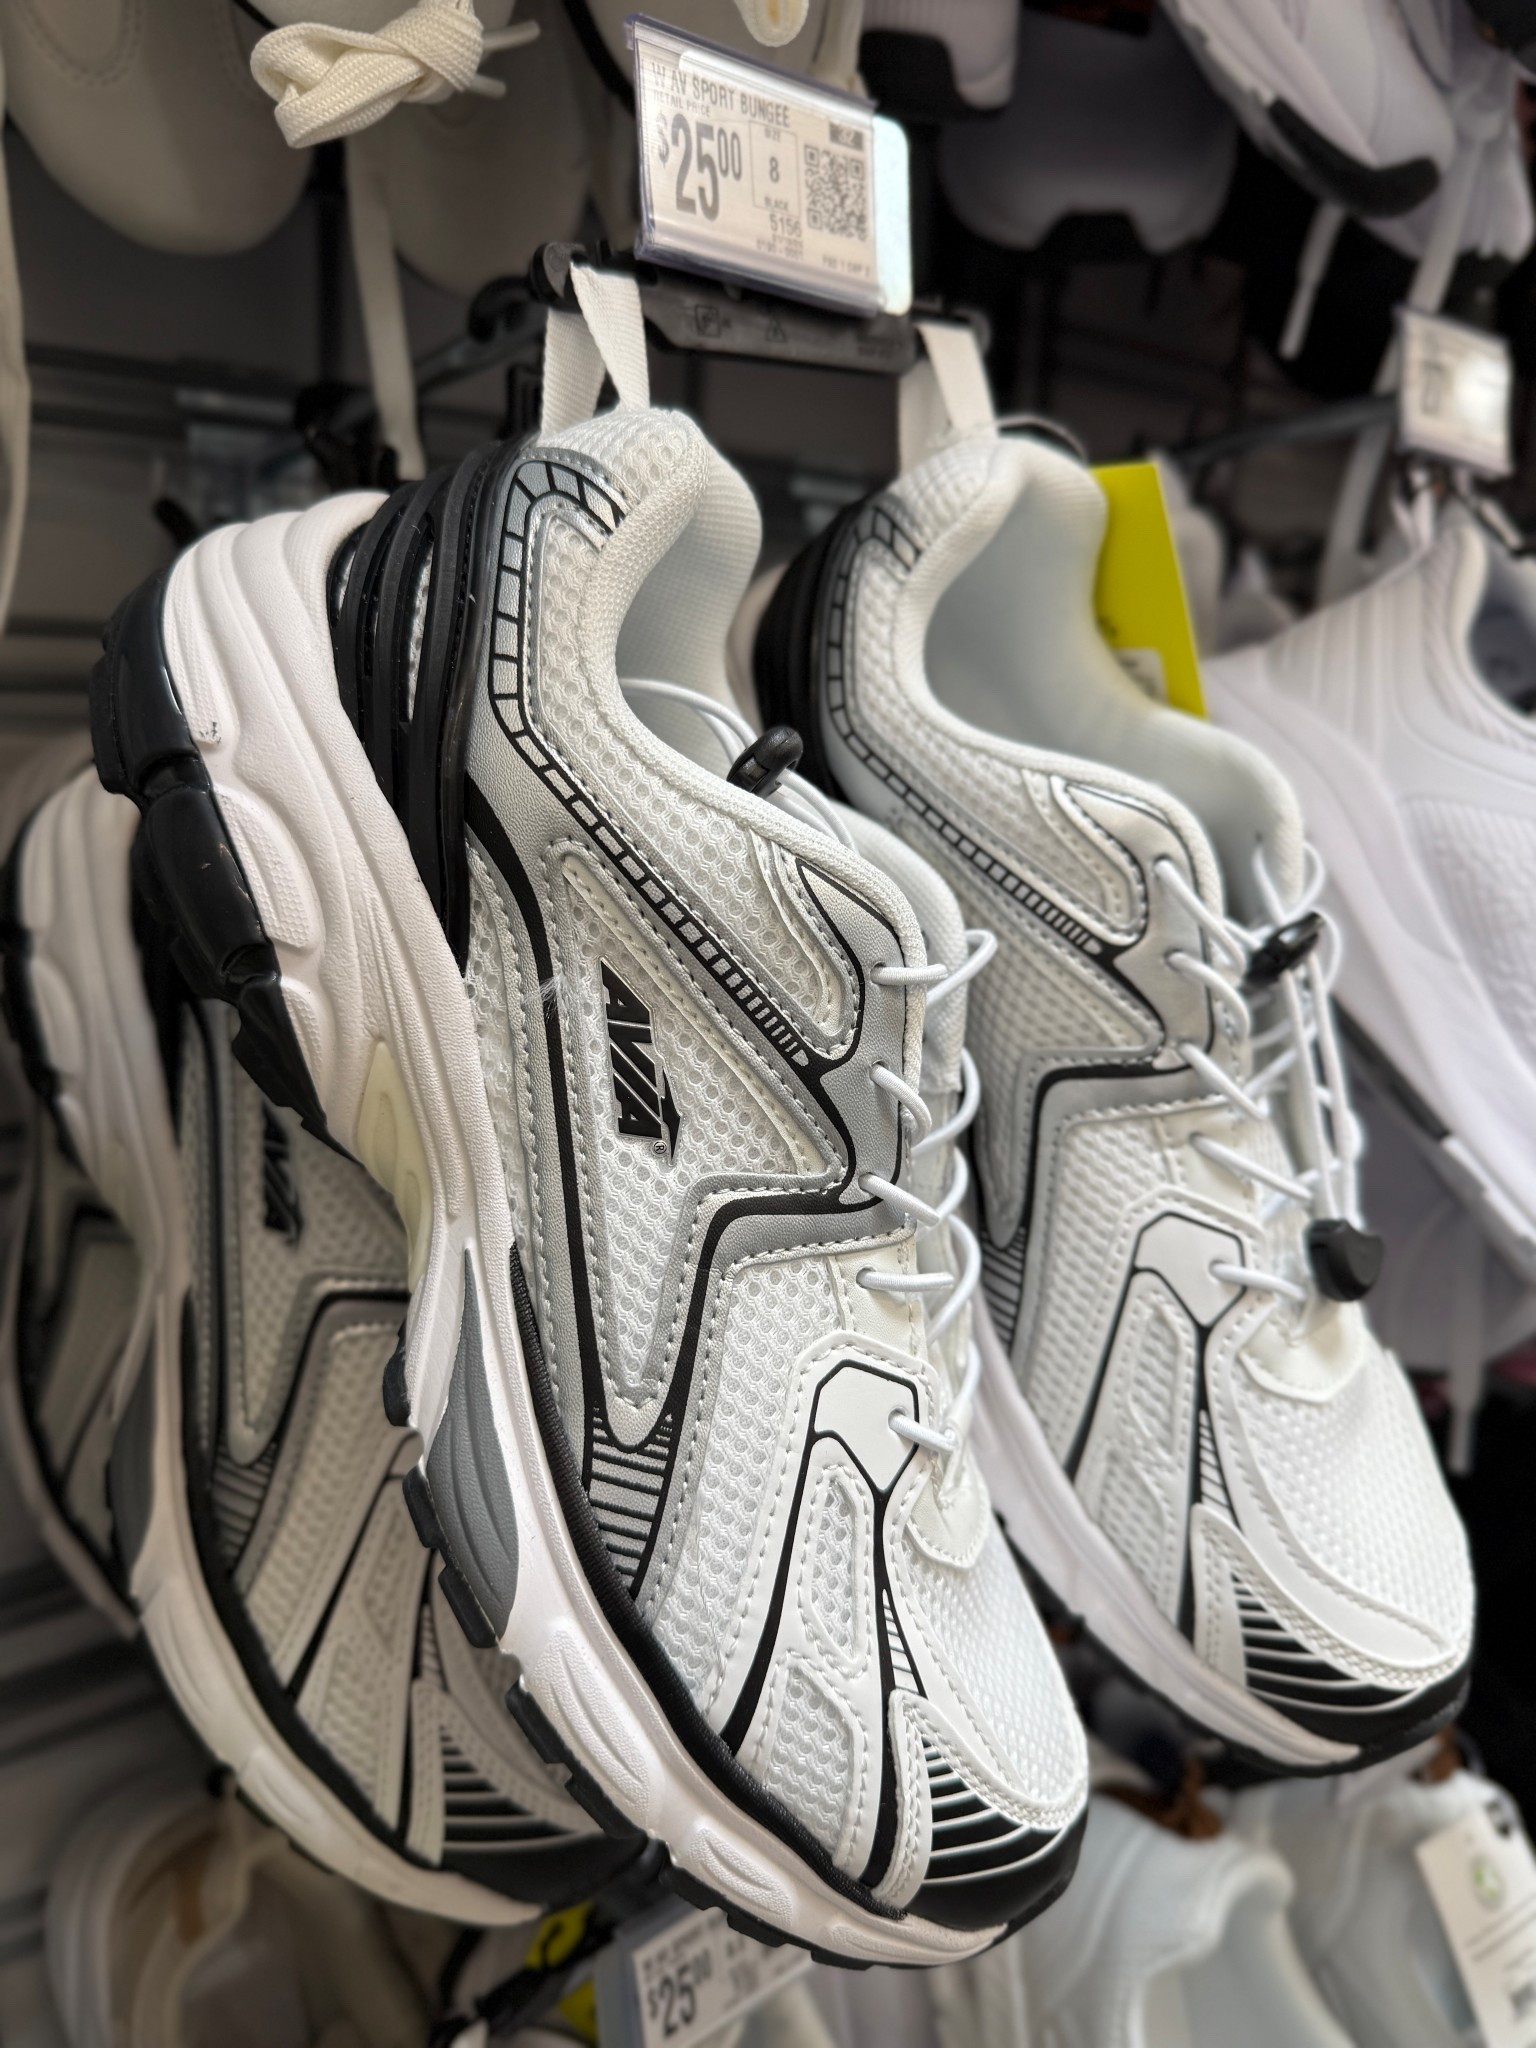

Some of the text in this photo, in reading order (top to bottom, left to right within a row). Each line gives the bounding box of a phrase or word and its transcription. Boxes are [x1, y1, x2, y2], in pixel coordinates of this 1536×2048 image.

[671, 68, 688, 96] AV
[692, 73, 735, 112] SPORT
[740, 91, 790, 129] BUNGEE
[769, 155, 780, 184] 8
